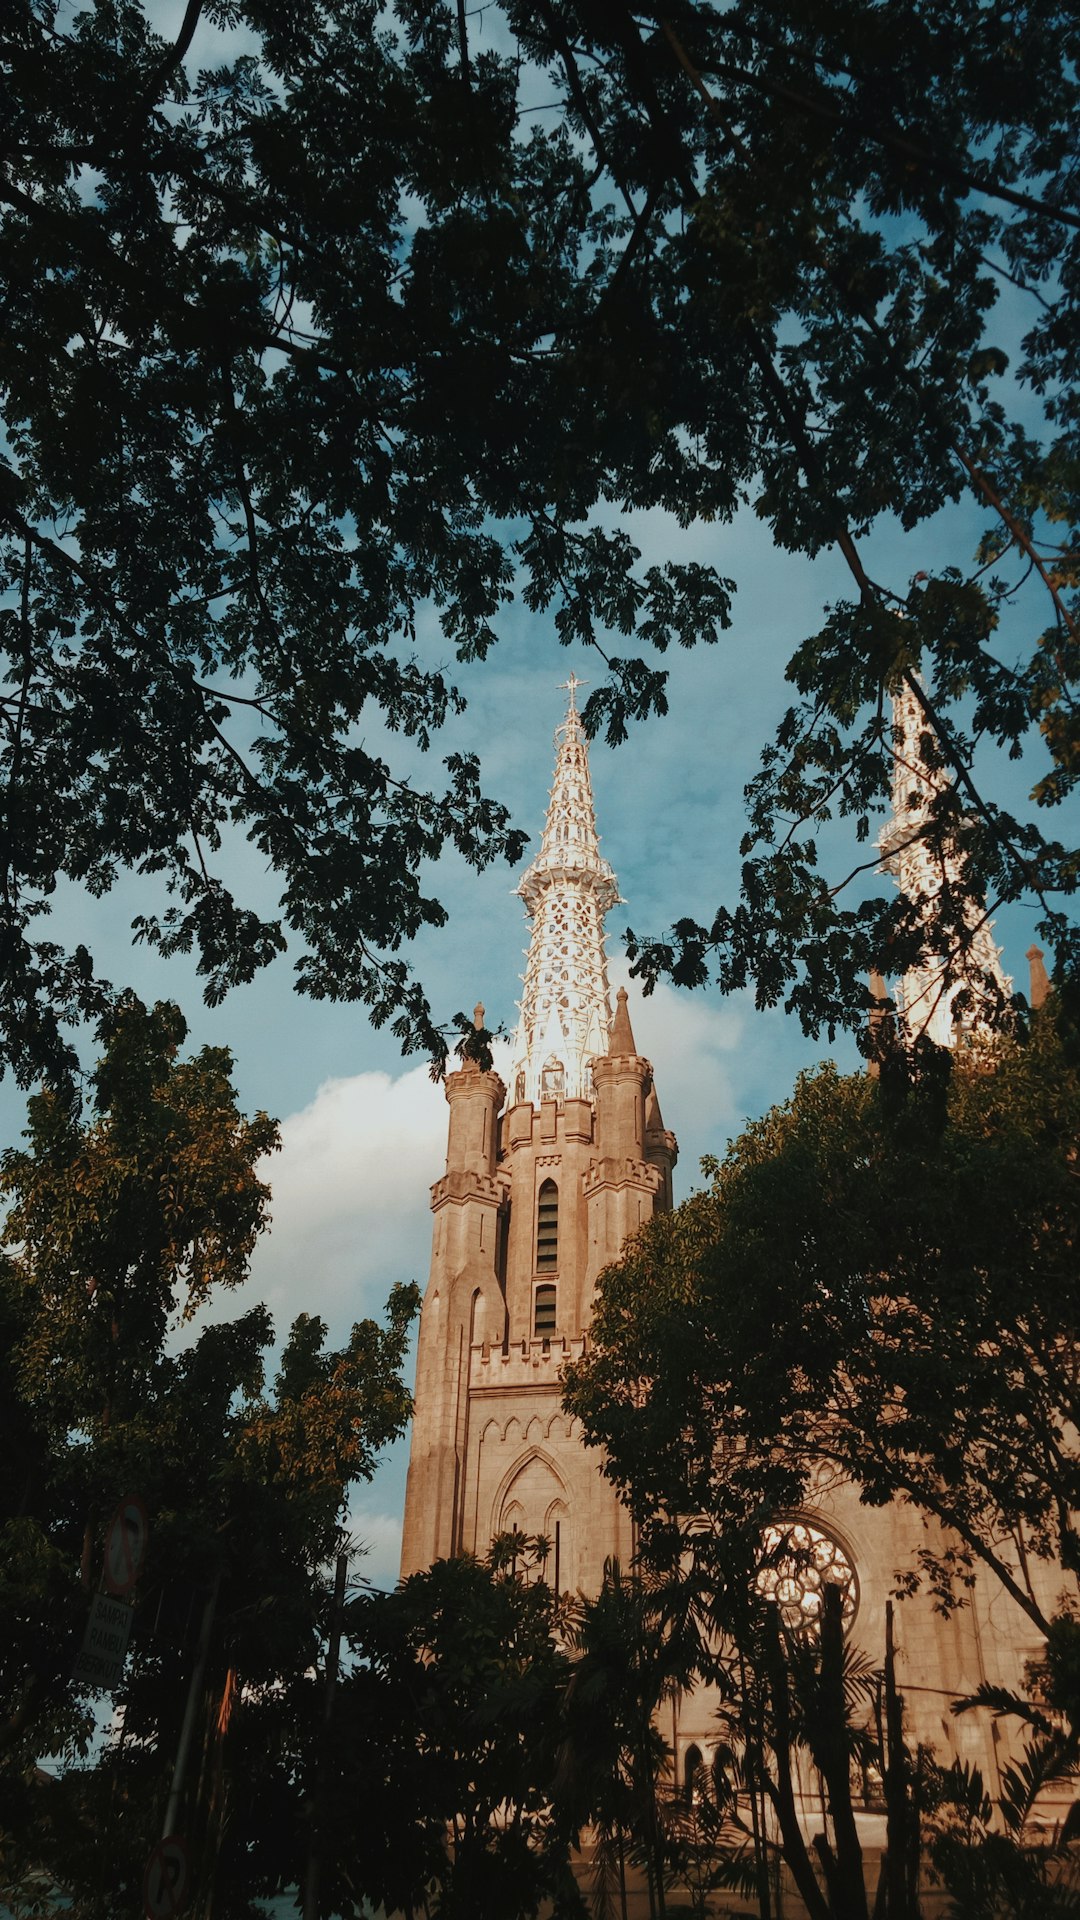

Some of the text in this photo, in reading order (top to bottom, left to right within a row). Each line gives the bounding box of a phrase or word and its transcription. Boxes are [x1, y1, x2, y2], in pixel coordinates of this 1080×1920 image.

[96, 1601, 128, 1627] SAMPAI
[90, 1628, 123, 1653] RAMBU
[79, 1652, 120, 1679] BERIKUT
[156, 1856, 181, 1904] P
